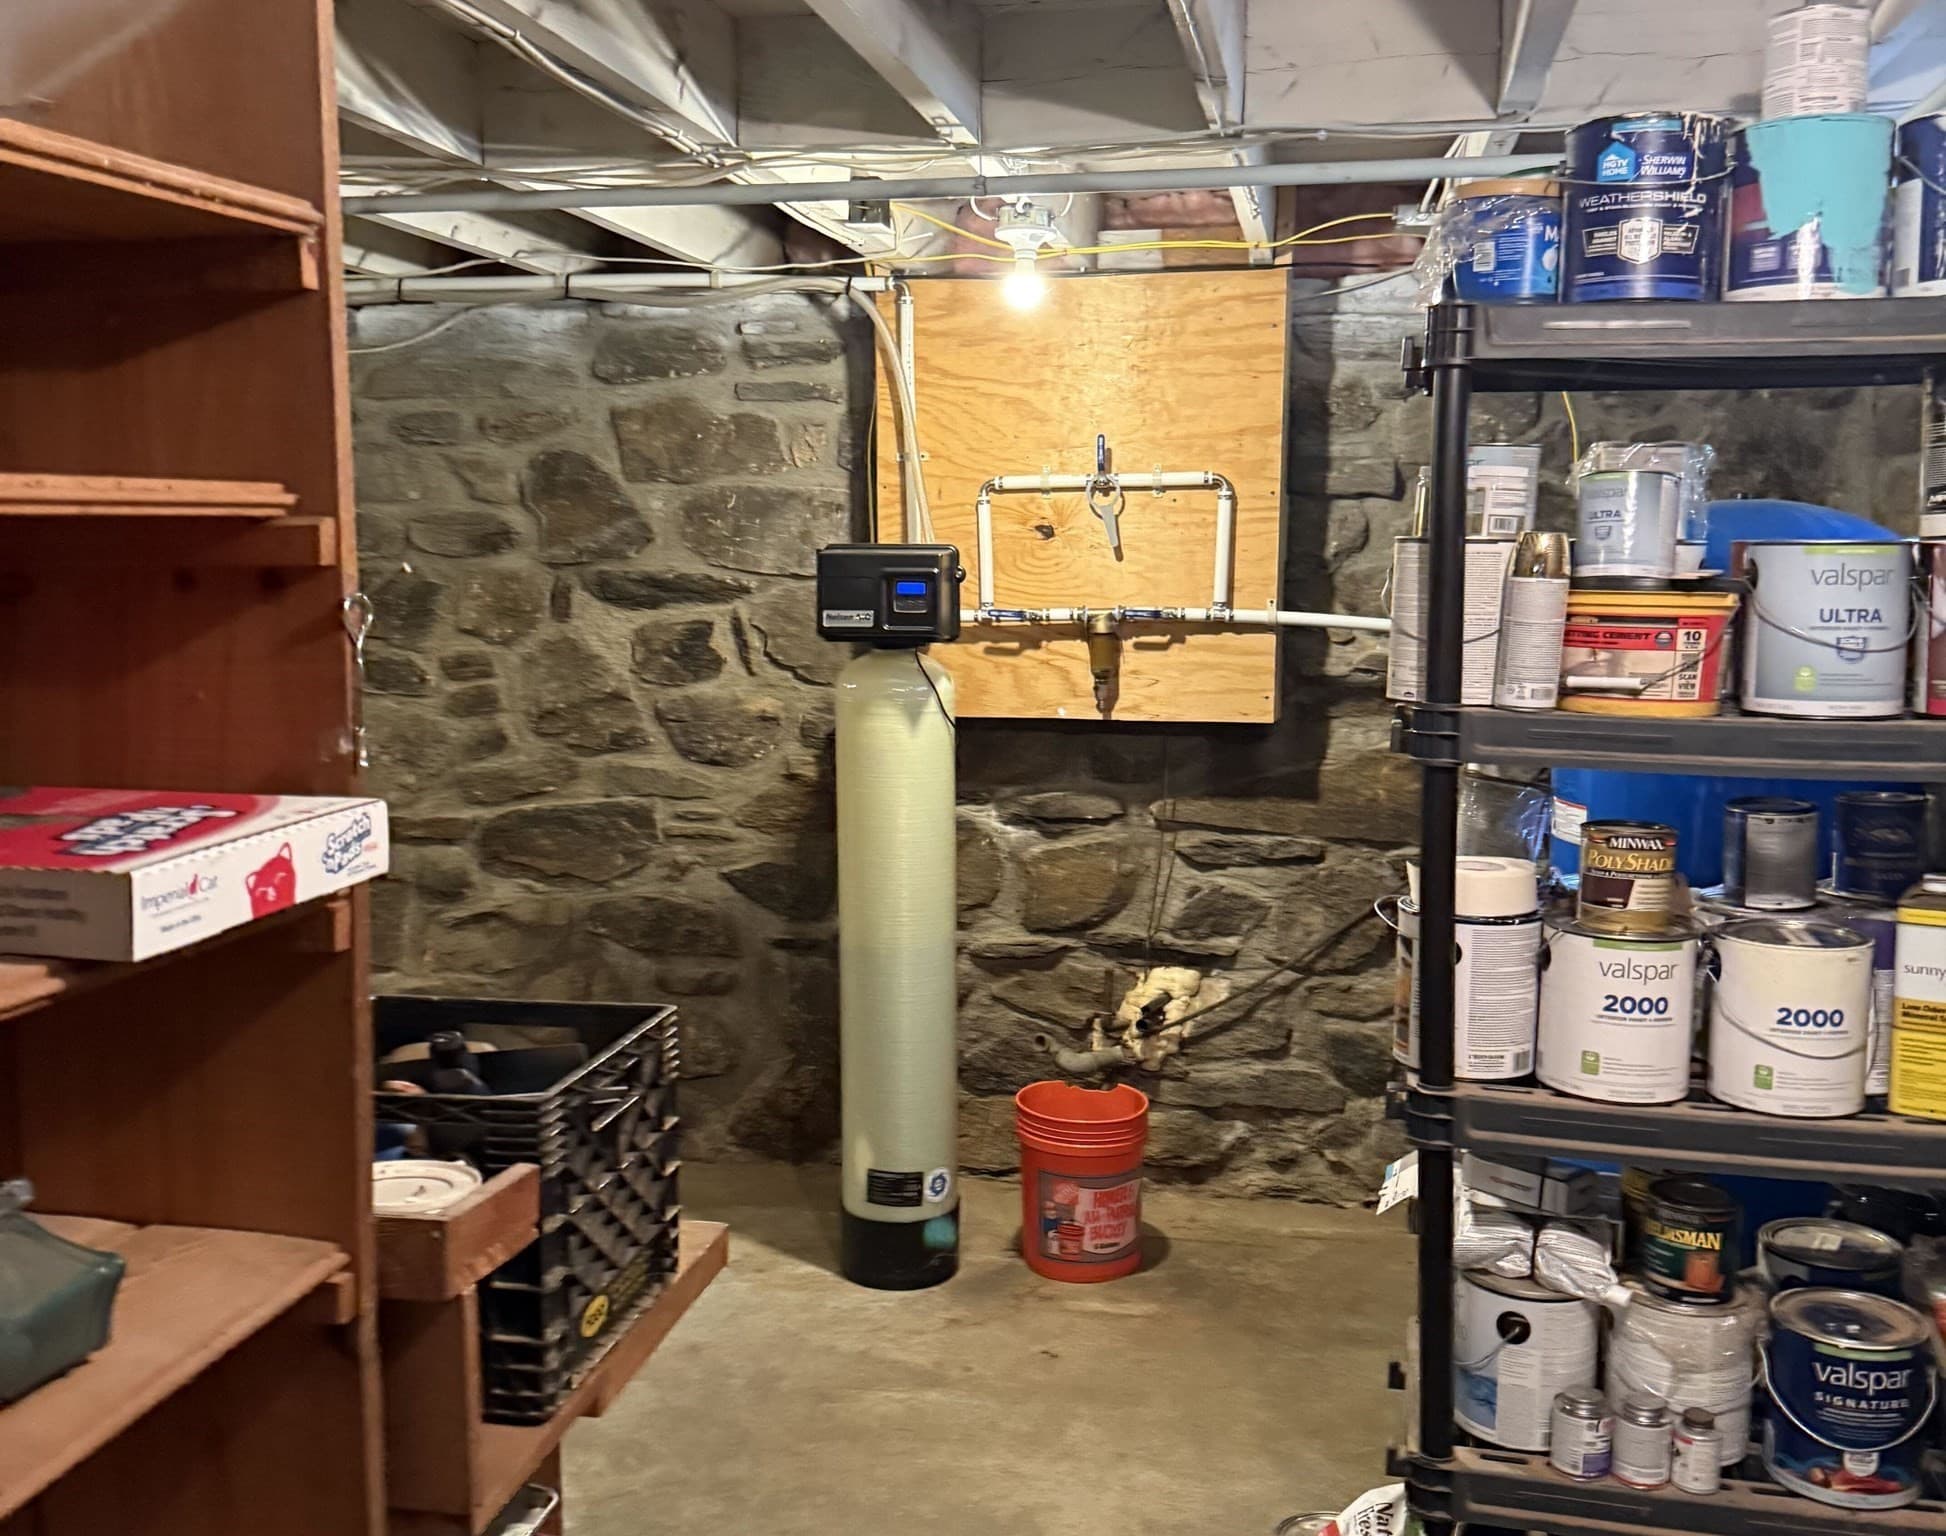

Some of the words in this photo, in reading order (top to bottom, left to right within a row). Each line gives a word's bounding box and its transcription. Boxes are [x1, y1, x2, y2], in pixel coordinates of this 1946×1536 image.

[1602, 160, 1629, 168] HGTV
[1642, 154, 1687, 165] SHERWIN
[1602, 167, 1629, 176] HOME
[1640, 164, 1687, 178] WILLIAMS
[1580, 191, 1707, 208] WEATHERSHIELD
[1811, 562, 1895, 591] valspar
[1819, 608, 1883, 624] ULTRA
[1683, 631, 1701, 641] 10
[1609, 837, 1665, 850] MINWAX
[1588, 848, 1673, 872] POLYSHAD
[1599, 957, 1681, 986] valspar
[1602, 994, 1669, 1015] 2000
[1776, 1007, 1844, 1028] 2000
[1811, 1361, 1913, 1395] valspar
[1813, 1391, 1911, 1410] SIGNATURE
[1356, 1505, 1375, 1536] Fres
[1375, 1502, 1394, 1536] Nat
